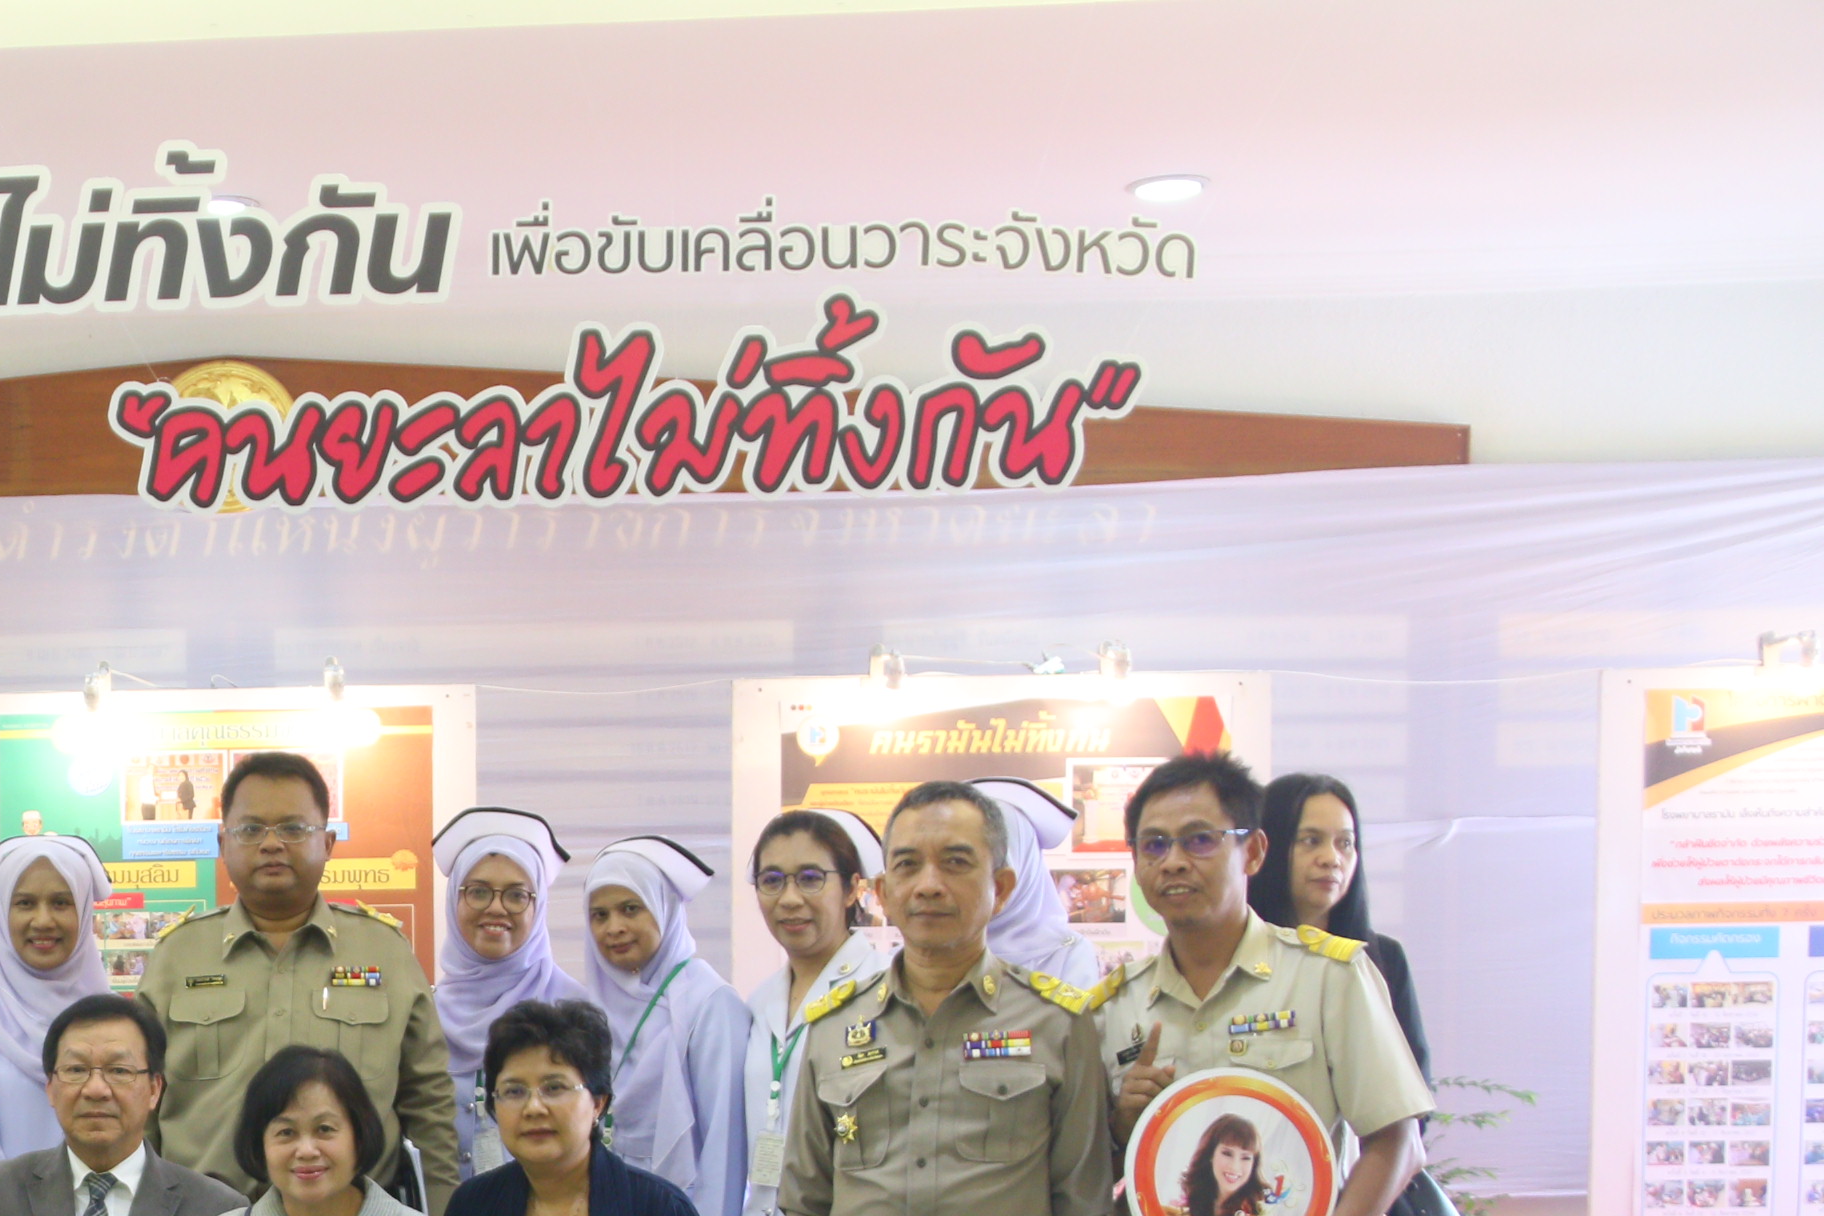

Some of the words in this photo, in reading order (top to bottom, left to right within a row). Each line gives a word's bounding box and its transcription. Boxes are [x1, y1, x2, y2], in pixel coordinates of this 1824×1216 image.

[488, 200, 1198, 283] เพื่อขับเคลื่อนวาระจังหวัด
[107, 864, 180, 890] มมุสลิม
